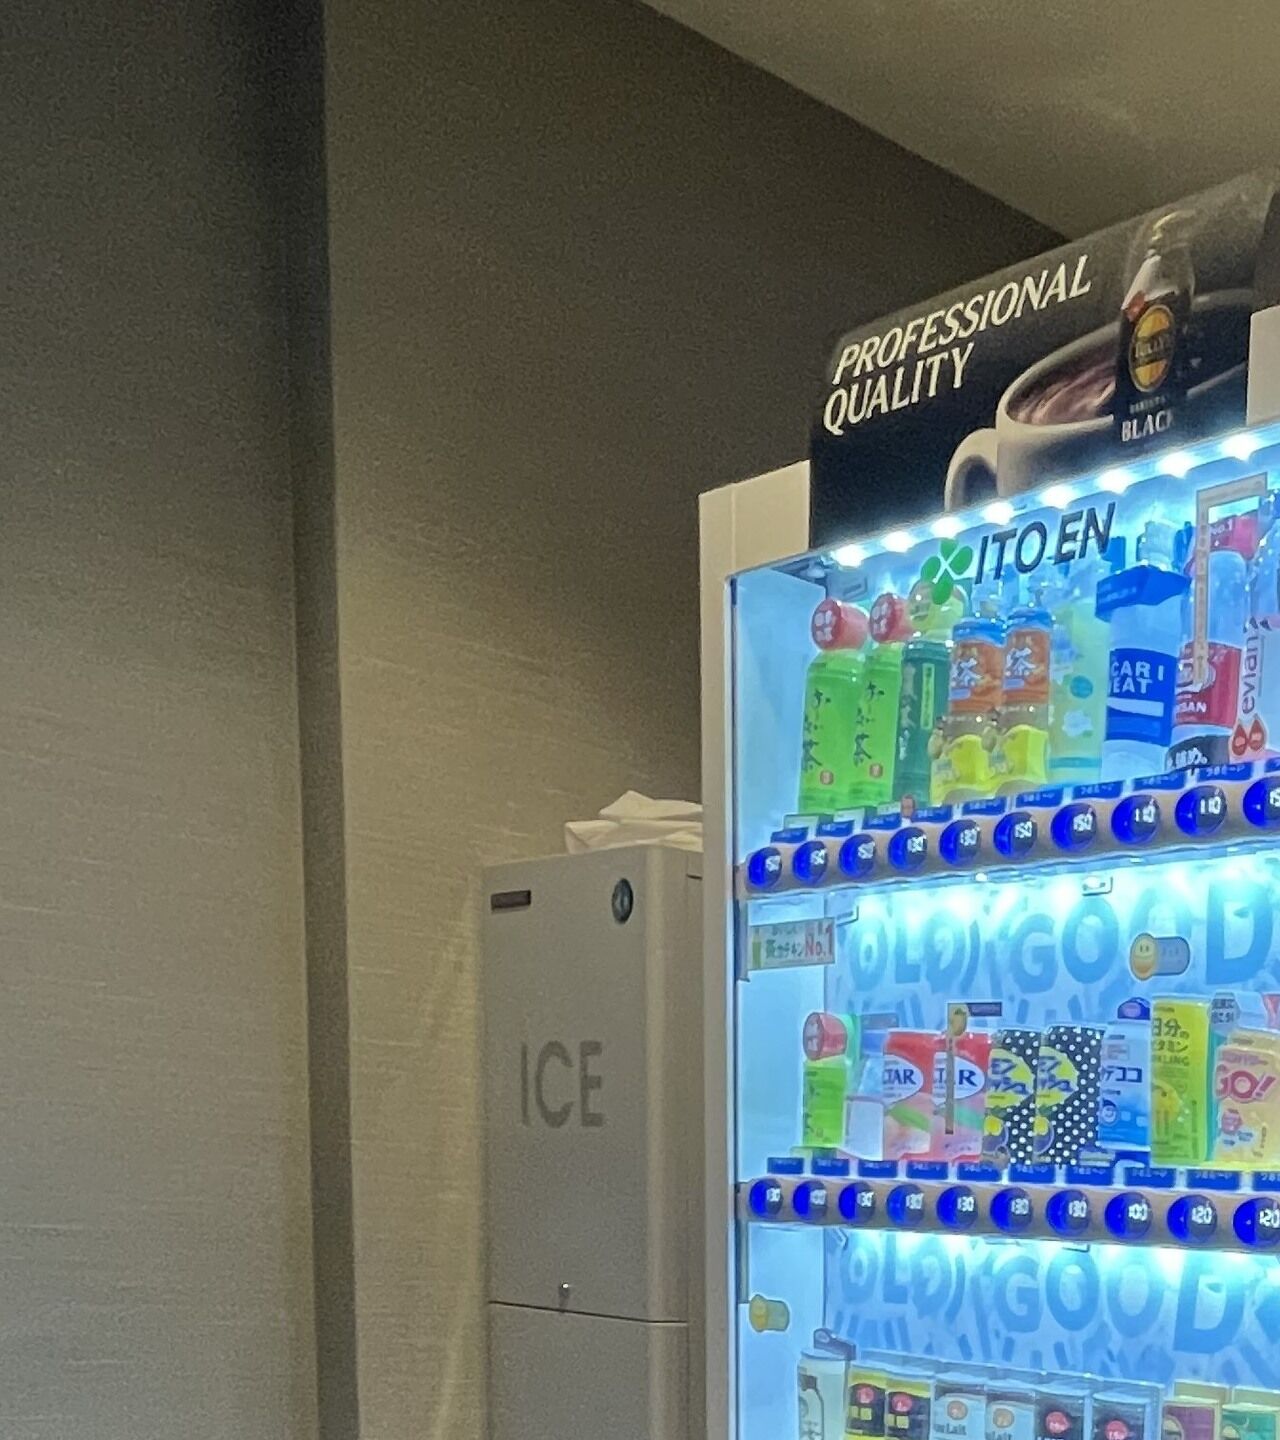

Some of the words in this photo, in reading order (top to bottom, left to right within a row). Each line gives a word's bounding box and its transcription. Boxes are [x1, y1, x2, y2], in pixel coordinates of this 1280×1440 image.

[832, 254, 1092, 385] PROFESSIONAL
[822, 343, 973, 435] QUALITY
[974, 522, 1046, 584] ITO
[1054, 502, 1116, 563] EN
[1109, 677, 1152, 694] EAT
[1242, 634, 1259, 714] evian
[1201, 796, 1221, 815] 110
[519, 1040, 604, 1128] ICE
[1151, 1040, 1189, 1052] タミン
[1259, 1208, 1280, 1229] 120
